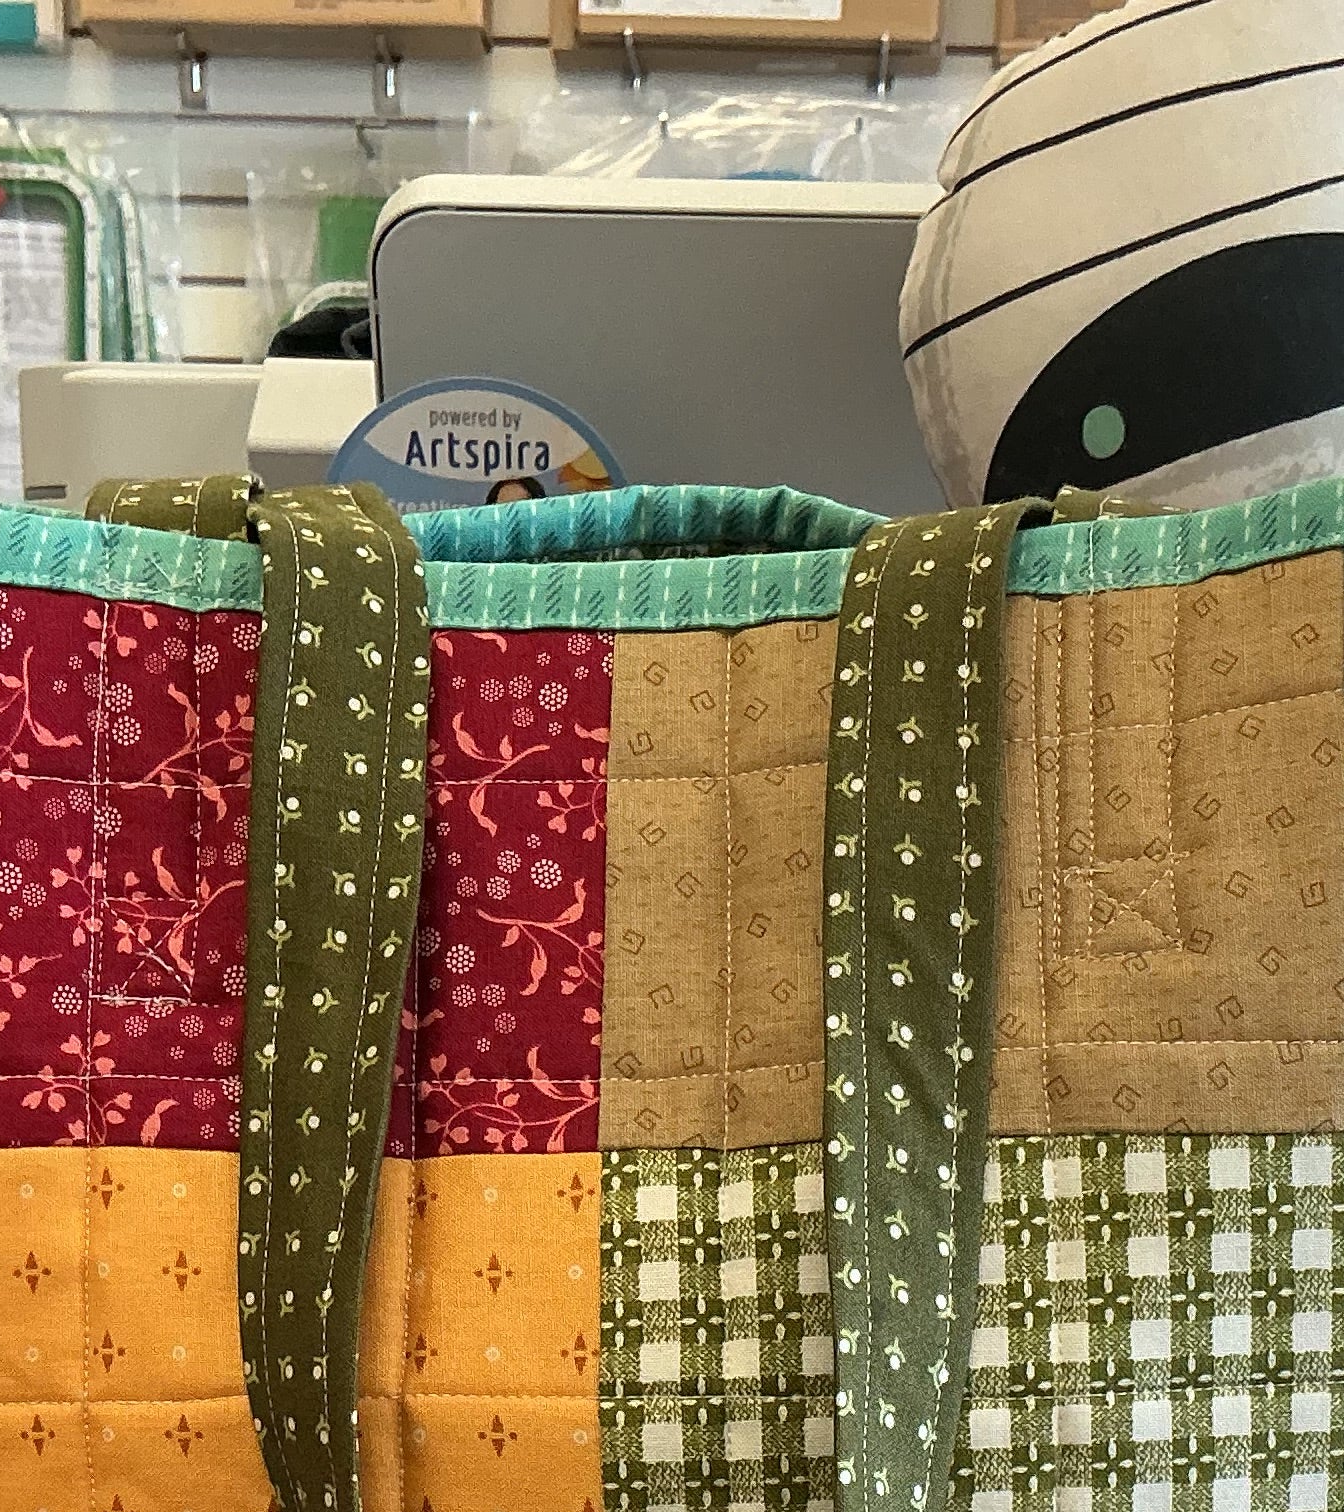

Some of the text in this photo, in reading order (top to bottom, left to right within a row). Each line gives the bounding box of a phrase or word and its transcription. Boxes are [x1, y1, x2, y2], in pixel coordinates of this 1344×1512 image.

[429, 408, 522, 432] powered by
[405, 431, 551, 476] Artspira
